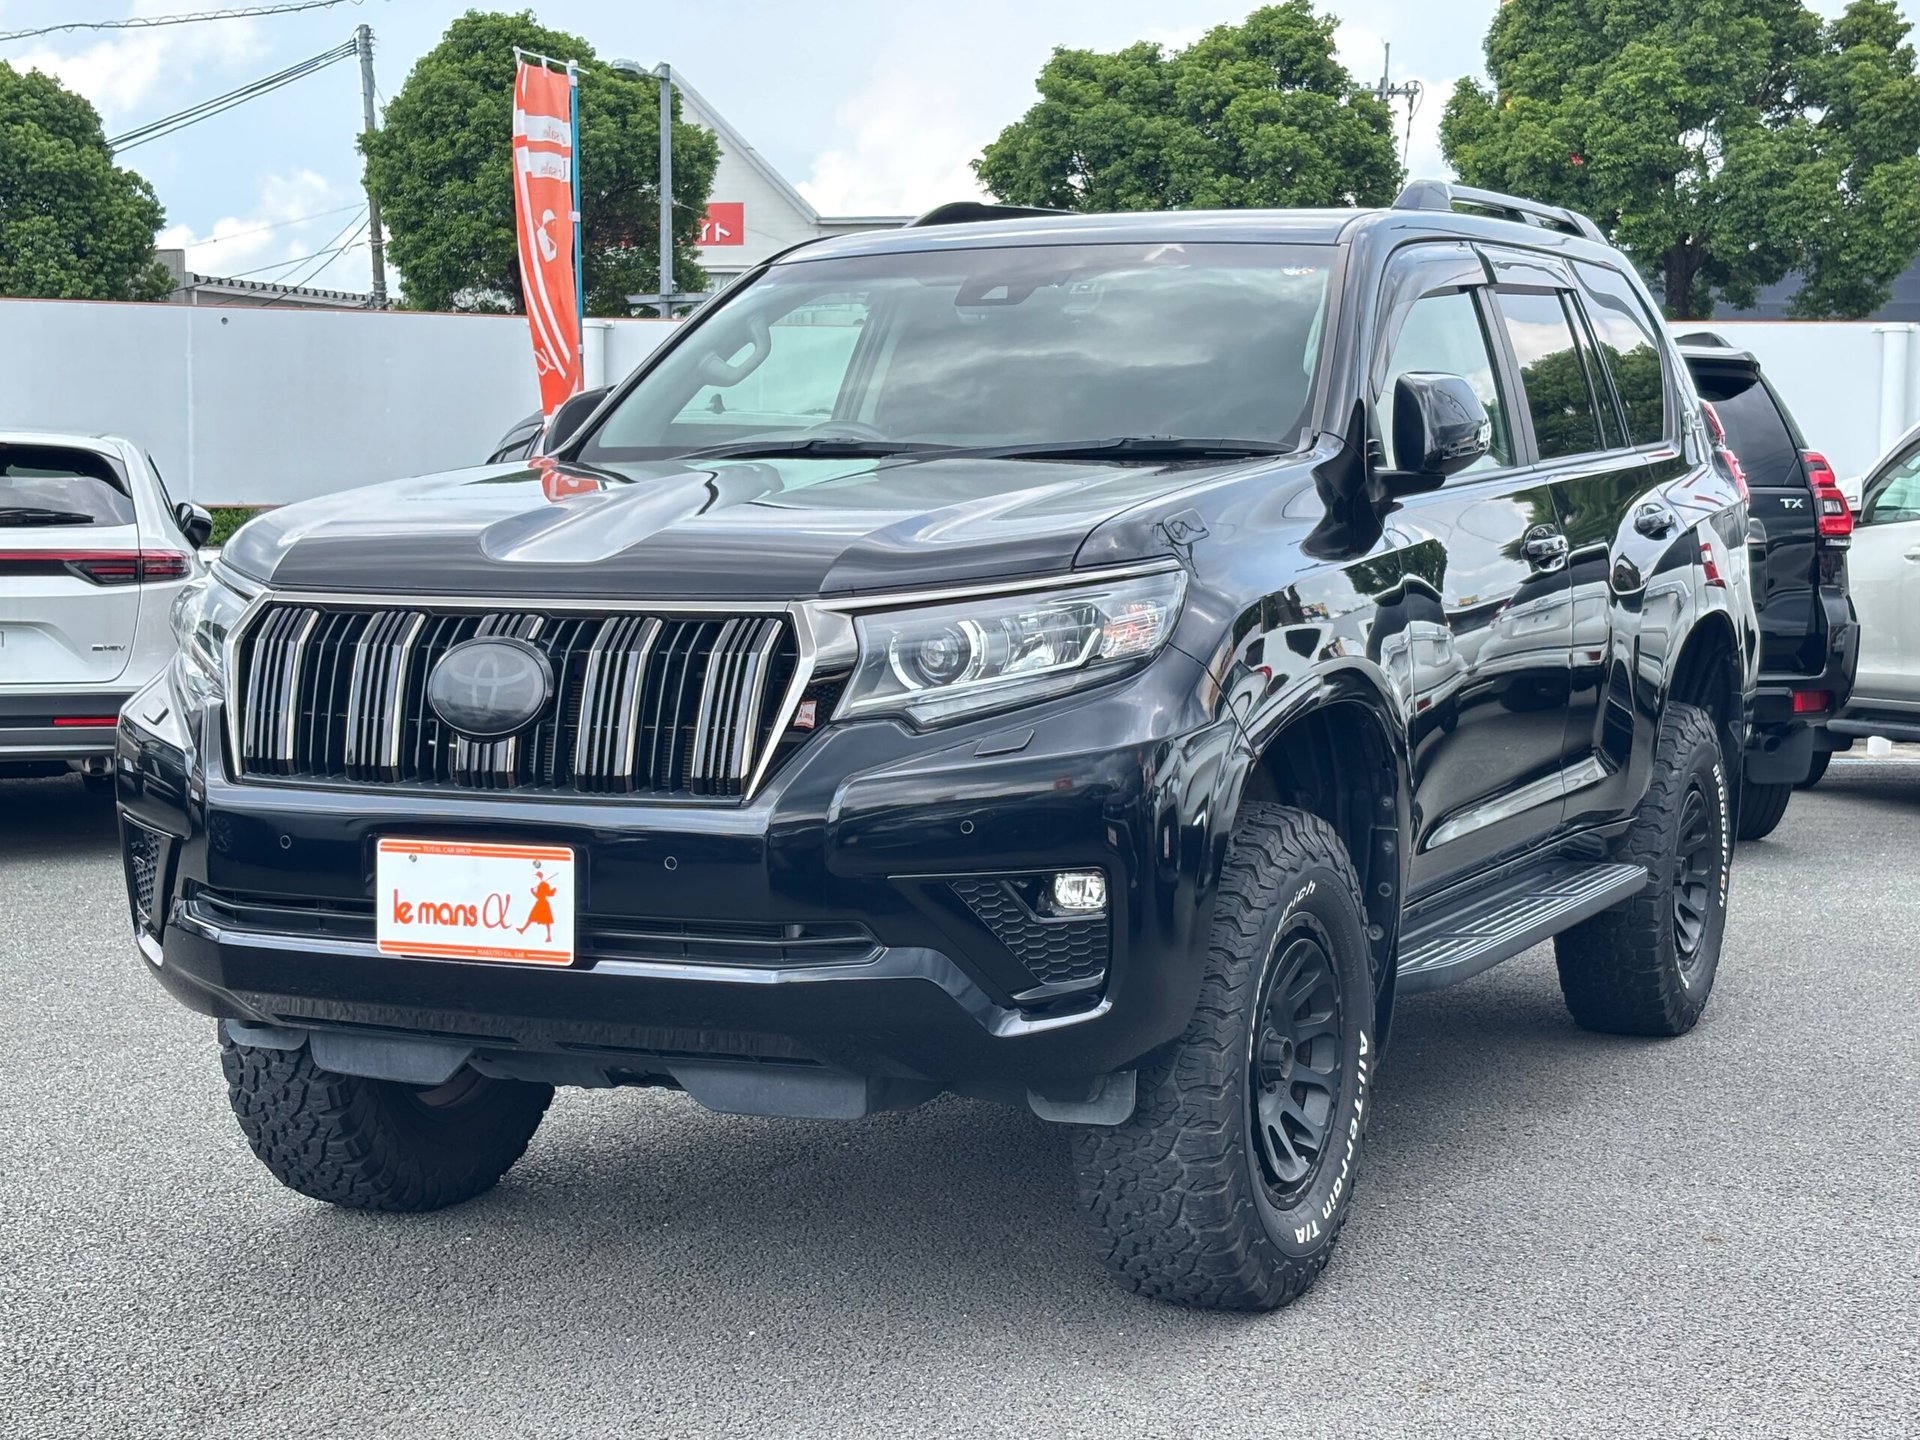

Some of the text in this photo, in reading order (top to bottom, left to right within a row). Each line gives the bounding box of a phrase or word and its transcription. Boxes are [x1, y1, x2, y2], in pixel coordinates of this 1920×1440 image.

[1780, 498, 1804, 509] TX
[393, 889, 414, 924] le
[418, 902, 478, 927] mans
[1321, 1030, 1369, 1220] All-Terrain
